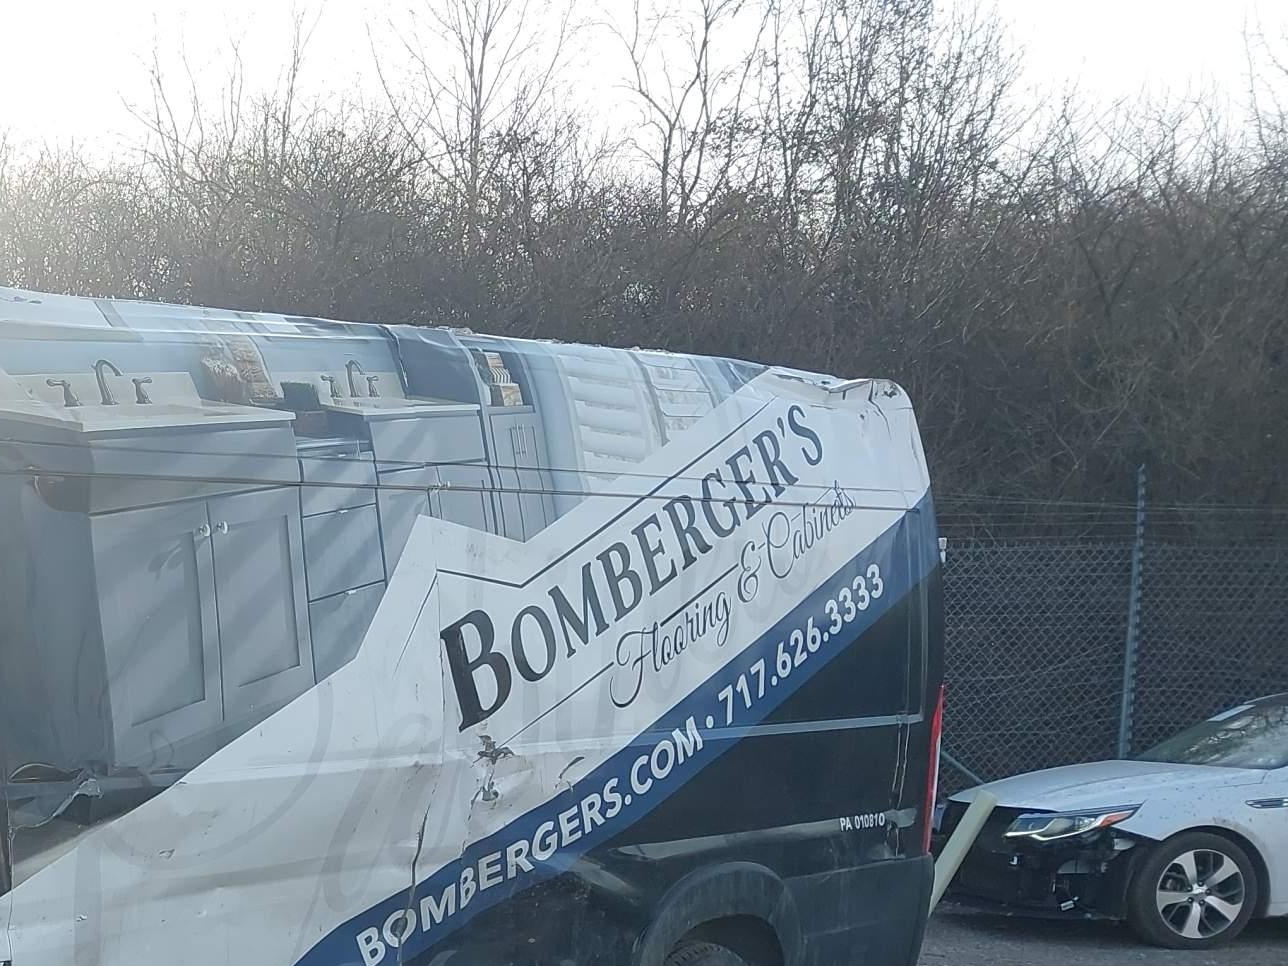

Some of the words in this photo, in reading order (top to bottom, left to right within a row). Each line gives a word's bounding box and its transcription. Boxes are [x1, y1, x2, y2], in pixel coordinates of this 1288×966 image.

[439, 404, 823, 733] BOMBERGER'S
[610, 591, 732, 708] Flooring
[737, 541, 764, 604] &
[764, 480, 857, 580] Cabinets
[718, 563, 885, 726] 717.626.3333
[840, 817, 852, 831] PA
[854, 813, 885, 829] 010810
